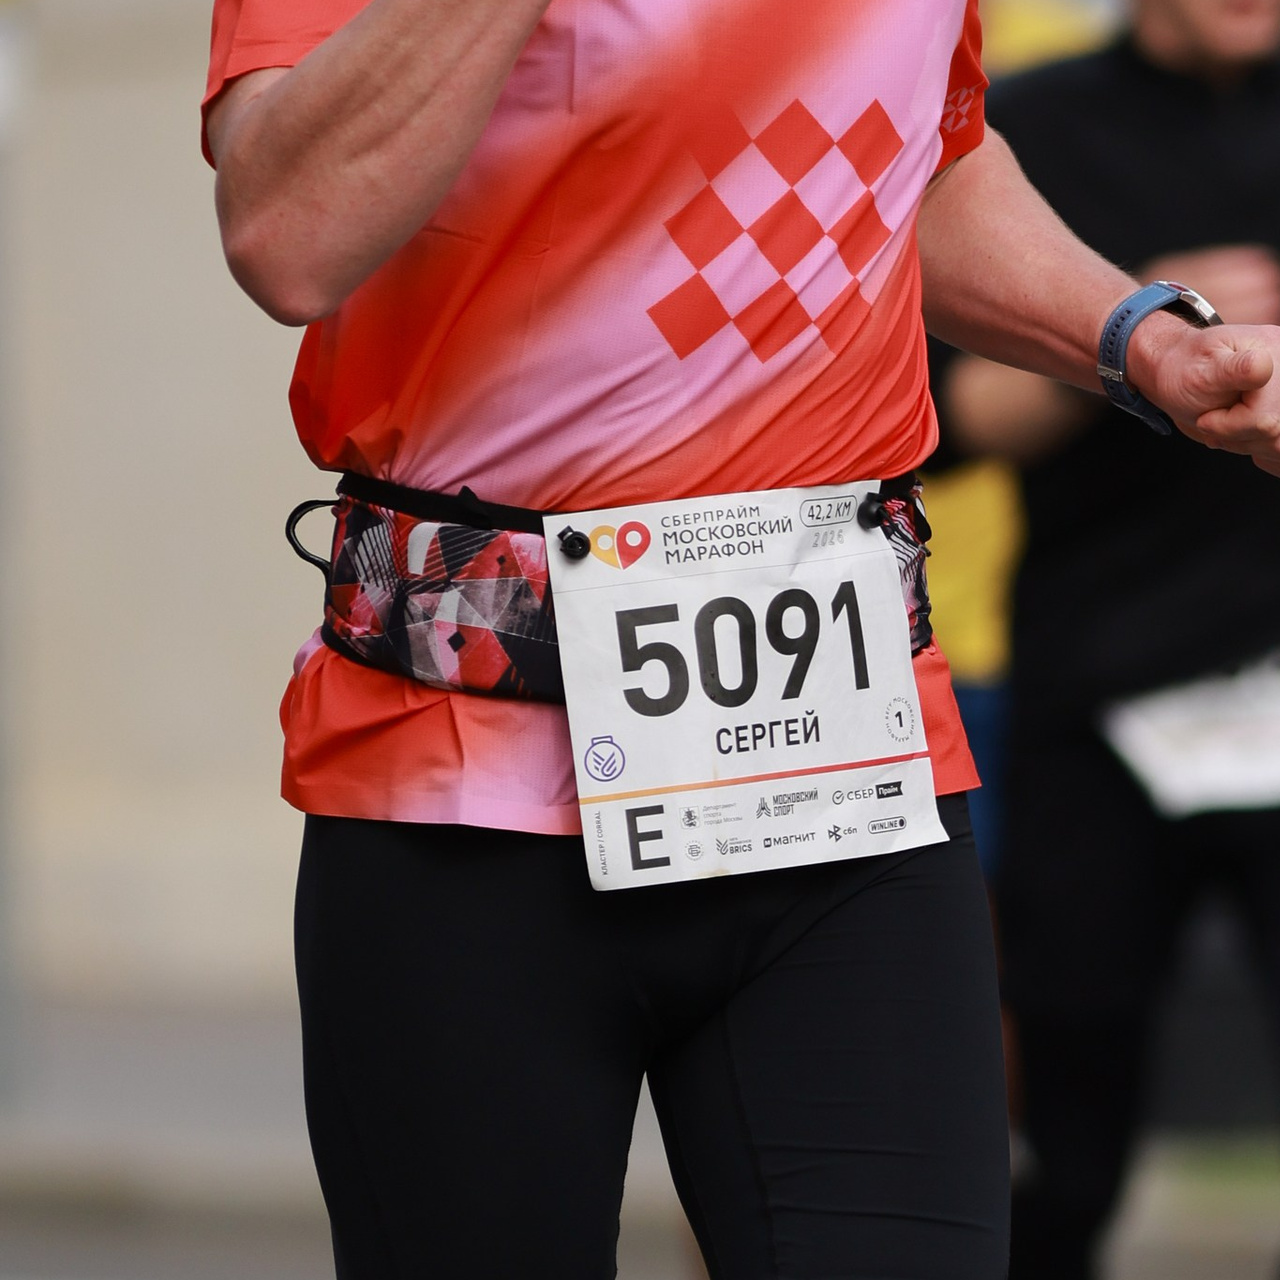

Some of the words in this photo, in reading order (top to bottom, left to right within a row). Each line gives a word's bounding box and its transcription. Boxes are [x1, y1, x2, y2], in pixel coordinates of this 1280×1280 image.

[661, 505, 760, 528] СБЕРПРАЙМ
[807, 504, 833, 521] 42,2
[662, 517, 793, 546] МОСКОВСКИЙ
[812, 529, 844, 548] 2026
[665, 540, 764, 564] МАРАФОН
[615, 581, 870, 717] 5091
[895, 710, 903, 728] 1
[716, 709, 820, 755] СЕРГЕЙ
[772, 788, 819, 805] МОСКОВСКИЙ
[847, 788, 874, 801] СБЕР
[773, 804, 794, 817] СПОРТ
[871, 820, 898, 832] WINLINE
[729, 844, 753, 855] BRICS
